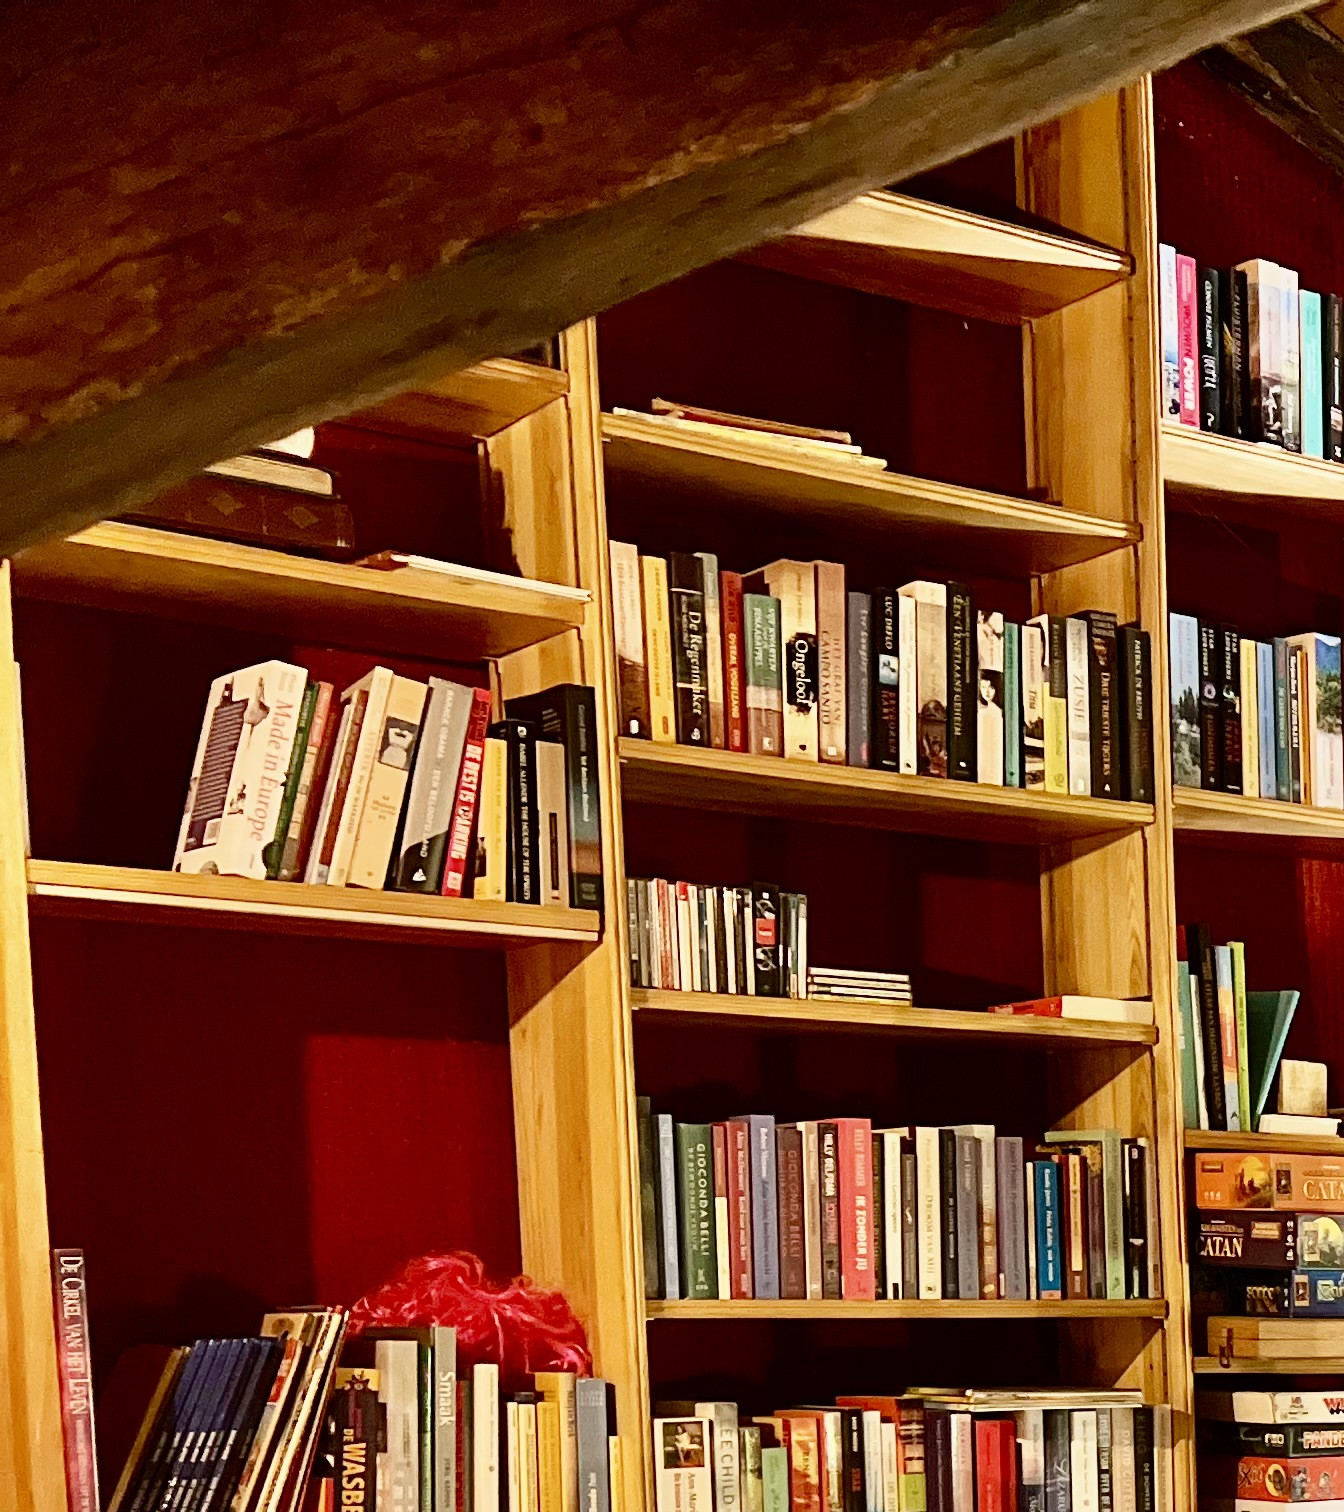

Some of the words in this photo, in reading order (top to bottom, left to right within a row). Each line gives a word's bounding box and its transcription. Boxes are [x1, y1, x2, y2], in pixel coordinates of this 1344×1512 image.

[1233, 294, 1242, 371] FLUISTERMAN
[689, 611, 703, 630] De
[885, 596, 893, 616] LUC
[792, 639, 811, 705] Ongeloof
[1100, 671, 1111, 696] DRIE
[267, 700, 295, 748] Made
[436, 727, 449, 759] OBAMA
[264, 755, 284, 770] in
[246, 774, 280, 842] Europe
[420, 835, 432, 857] LAND
[696, 1143, 708, 1218] GIOCONDA
[787, 1150, 800, 1220] GIOCONDA
[855, 1195, 866, 1207] IK
[700, 1221, 710, 1256] BELLI
[789, 1225, 801, 1257] BELLI
[856, 1209, 867, 1255] ZONDER
[1198, 1237, 1243, 1257] CATAN
[856, 1257, 868, 1271] JIJ
[68, 1353, 86, 1374] HET
[69, 1377, 90, 1415] LEVEN
[439, 1371, 455, 1426] Smaak
[343, 1428, 354, 1442] DE
[1137, 1416, 1145, 1455] KING
[721, 1454, 735, 1505] CHILD
